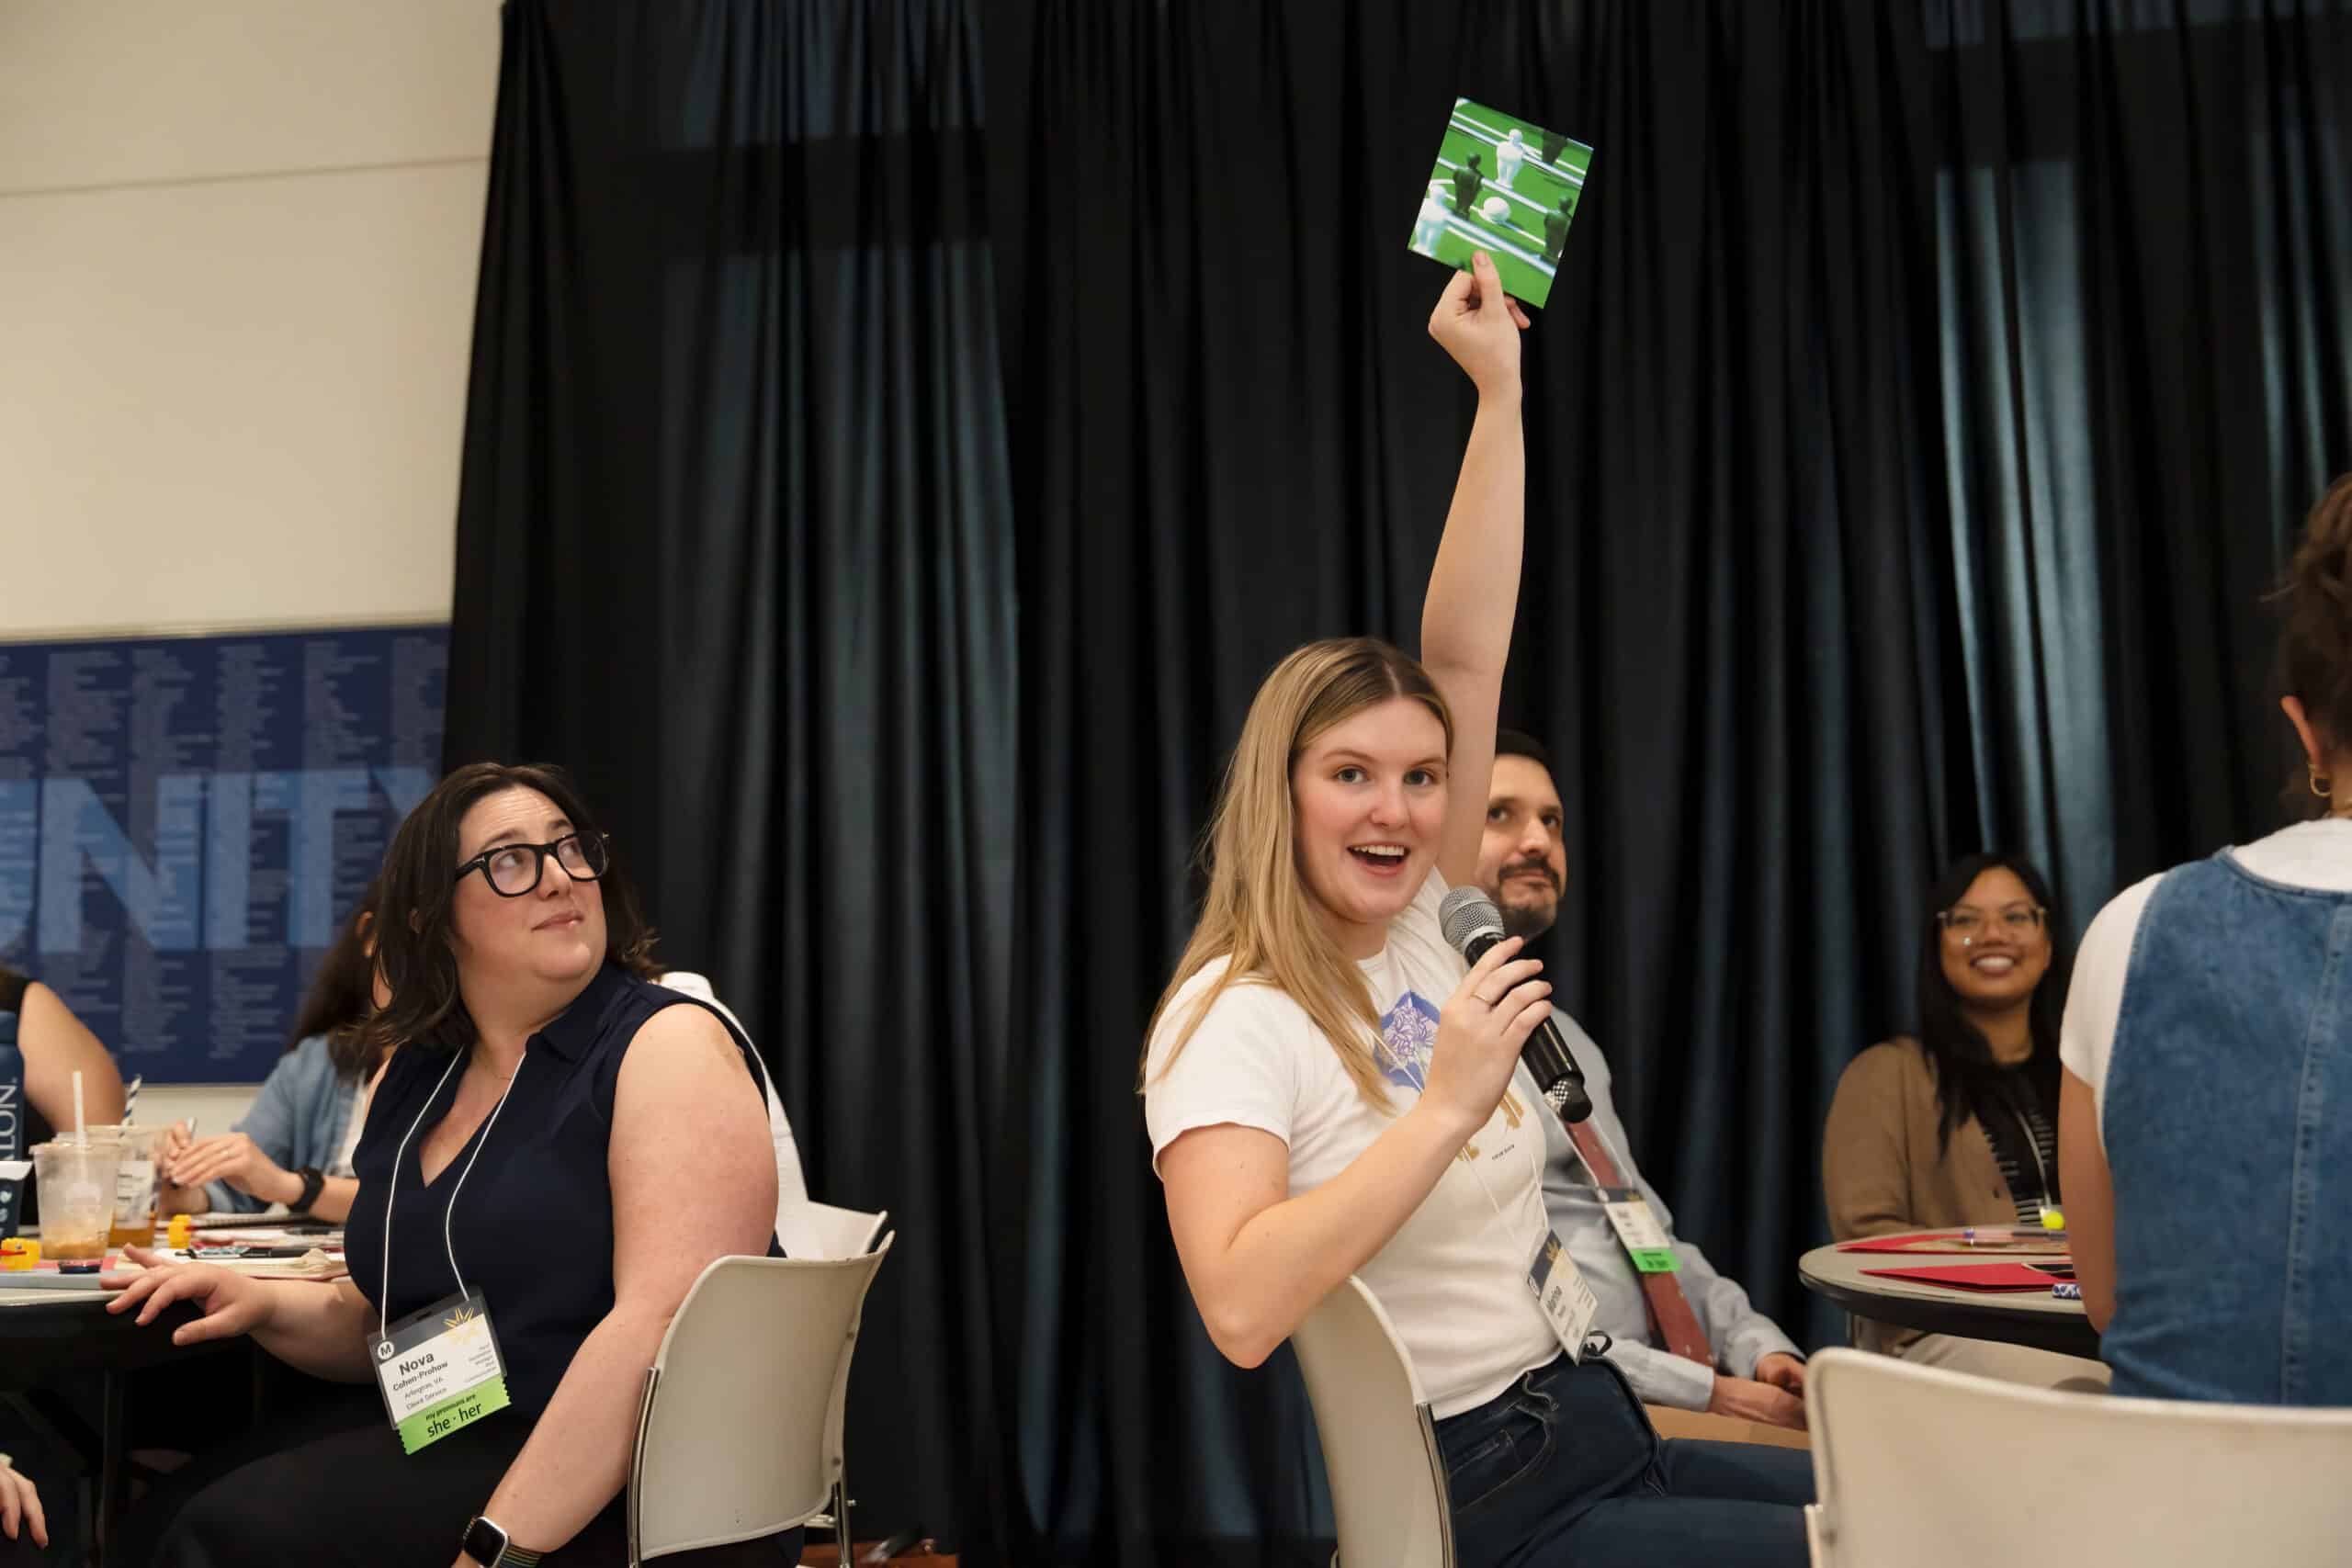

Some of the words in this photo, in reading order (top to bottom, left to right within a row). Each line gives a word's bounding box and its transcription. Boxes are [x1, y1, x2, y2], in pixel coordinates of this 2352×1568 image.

[399, 1353, 435, 1376] Nova
[427, 1419, 451, 1438] she
[458, 1403, 481, 1422] her
